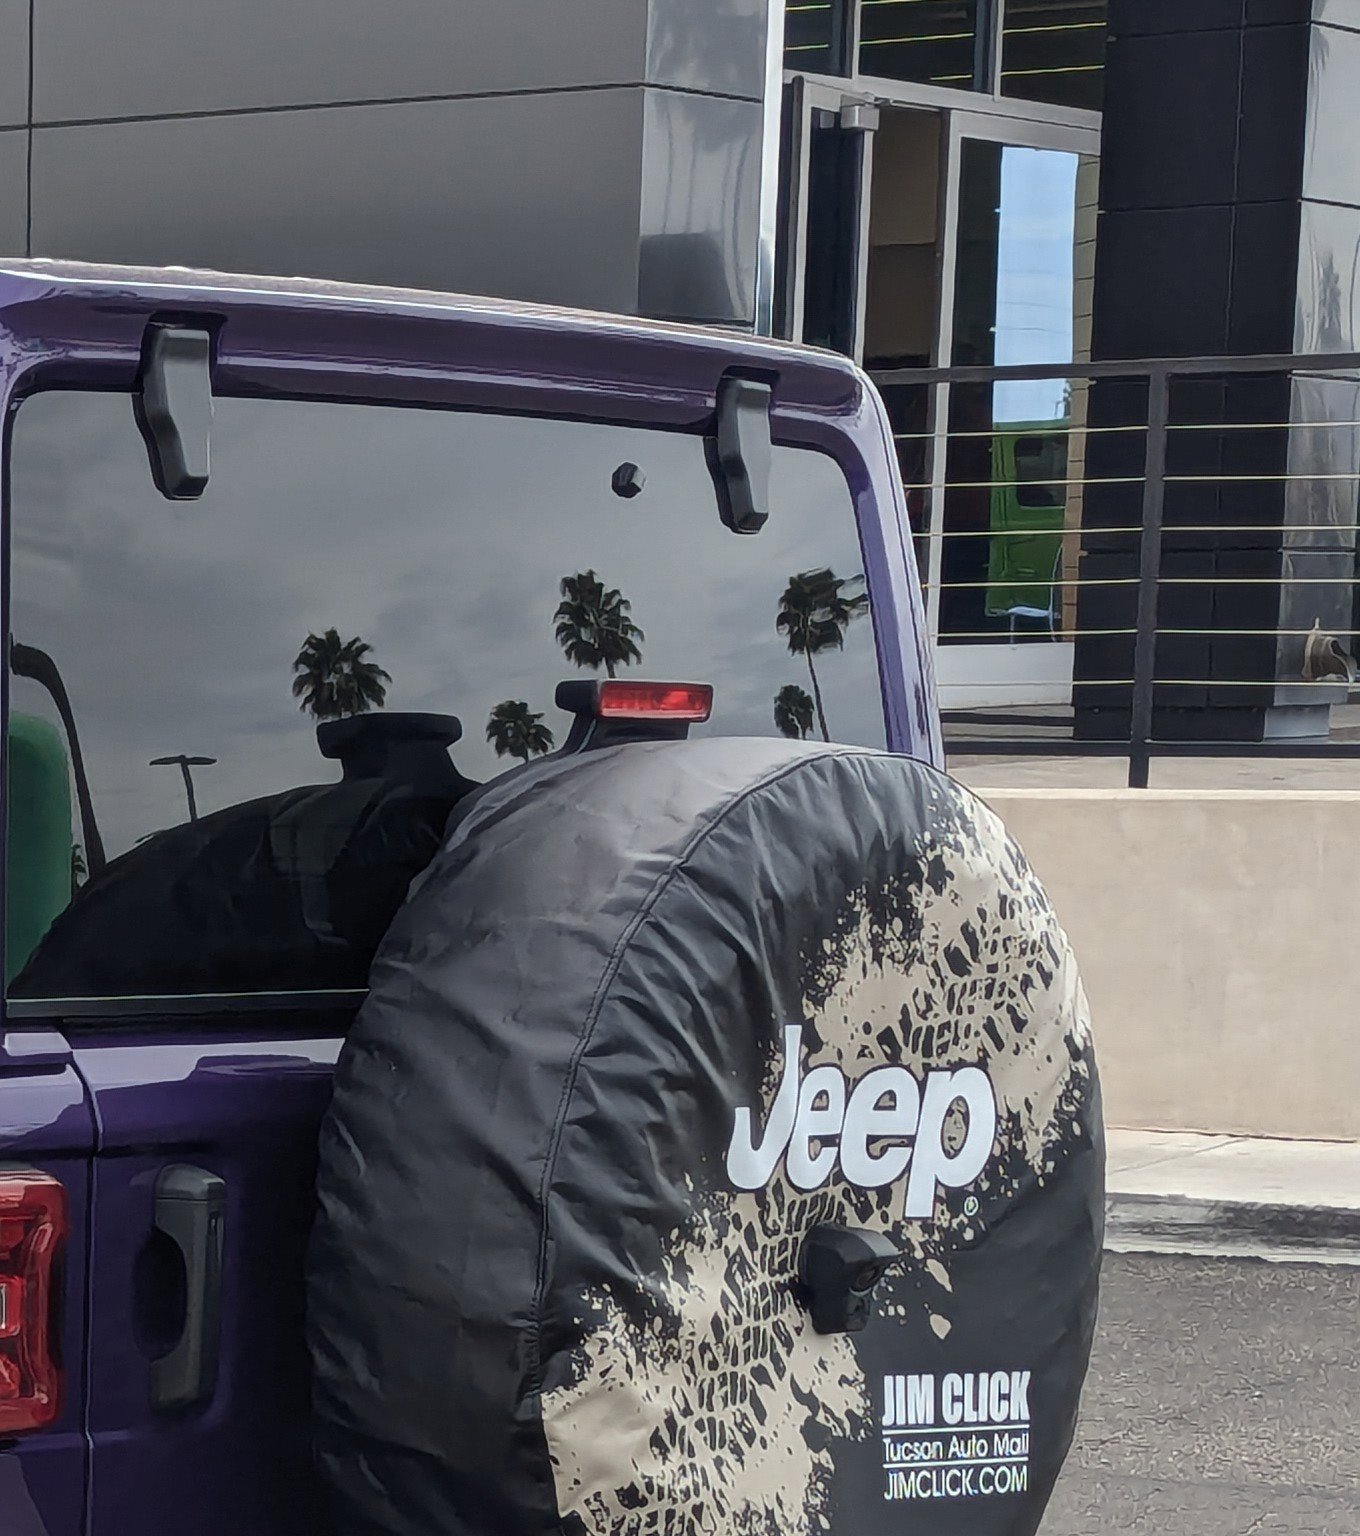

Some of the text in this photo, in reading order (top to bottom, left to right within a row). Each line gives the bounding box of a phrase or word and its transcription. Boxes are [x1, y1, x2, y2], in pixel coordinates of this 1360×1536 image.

[726, 1024, 996, 1219] Jeep
[882, 1371, 1031, 1426] JIM CLICK
[882, 1437, 943, 1462] Tucson
[948, 1434, 989, 1459] Auto
[884, 1465, 1028, 1500] JIMCLICK.COM
